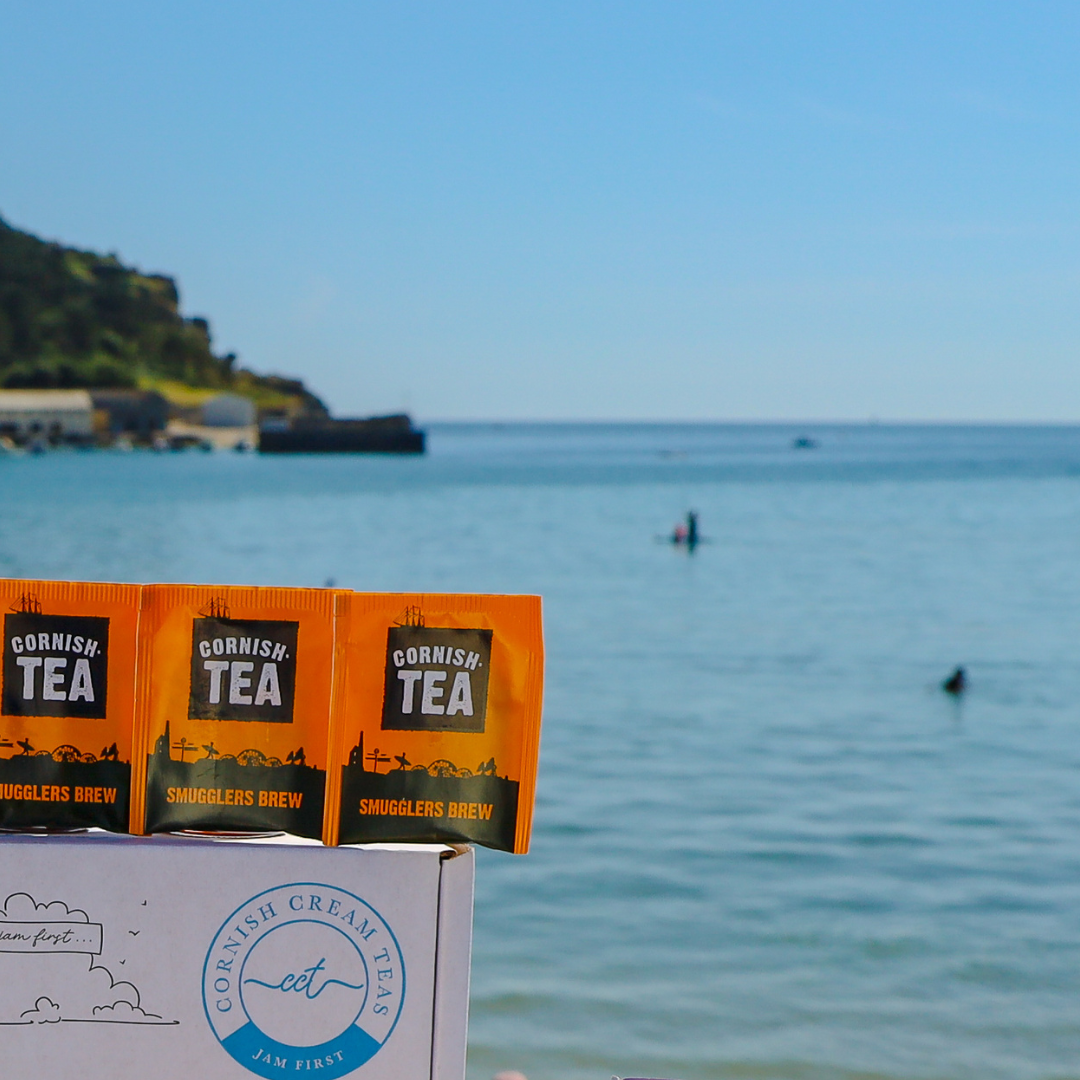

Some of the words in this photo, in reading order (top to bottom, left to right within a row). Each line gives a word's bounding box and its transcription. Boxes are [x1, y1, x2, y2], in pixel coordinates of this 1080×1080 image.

[16, 656, 95, 702] TEA
[203, 660, 282, 706] TEA
[397, 670, 474, 716] TEA
[74, 786, 117, 804] BREW
[166, 787, 255, 806] SMUGGLERS
[258, 790, 304, 809] BREW
[360, 798, 444, 818] SMUGGLERS
[448, 801, 493, 820] BREW
[214, 902, 278, 1013] CORNISH
[289, 894, 378, 942] CREAM
[372, 947, 394, 1016] TEAS
[252, 1048, 287, 1069] JAM
[295, 1050, 345, 1070] FIRST
